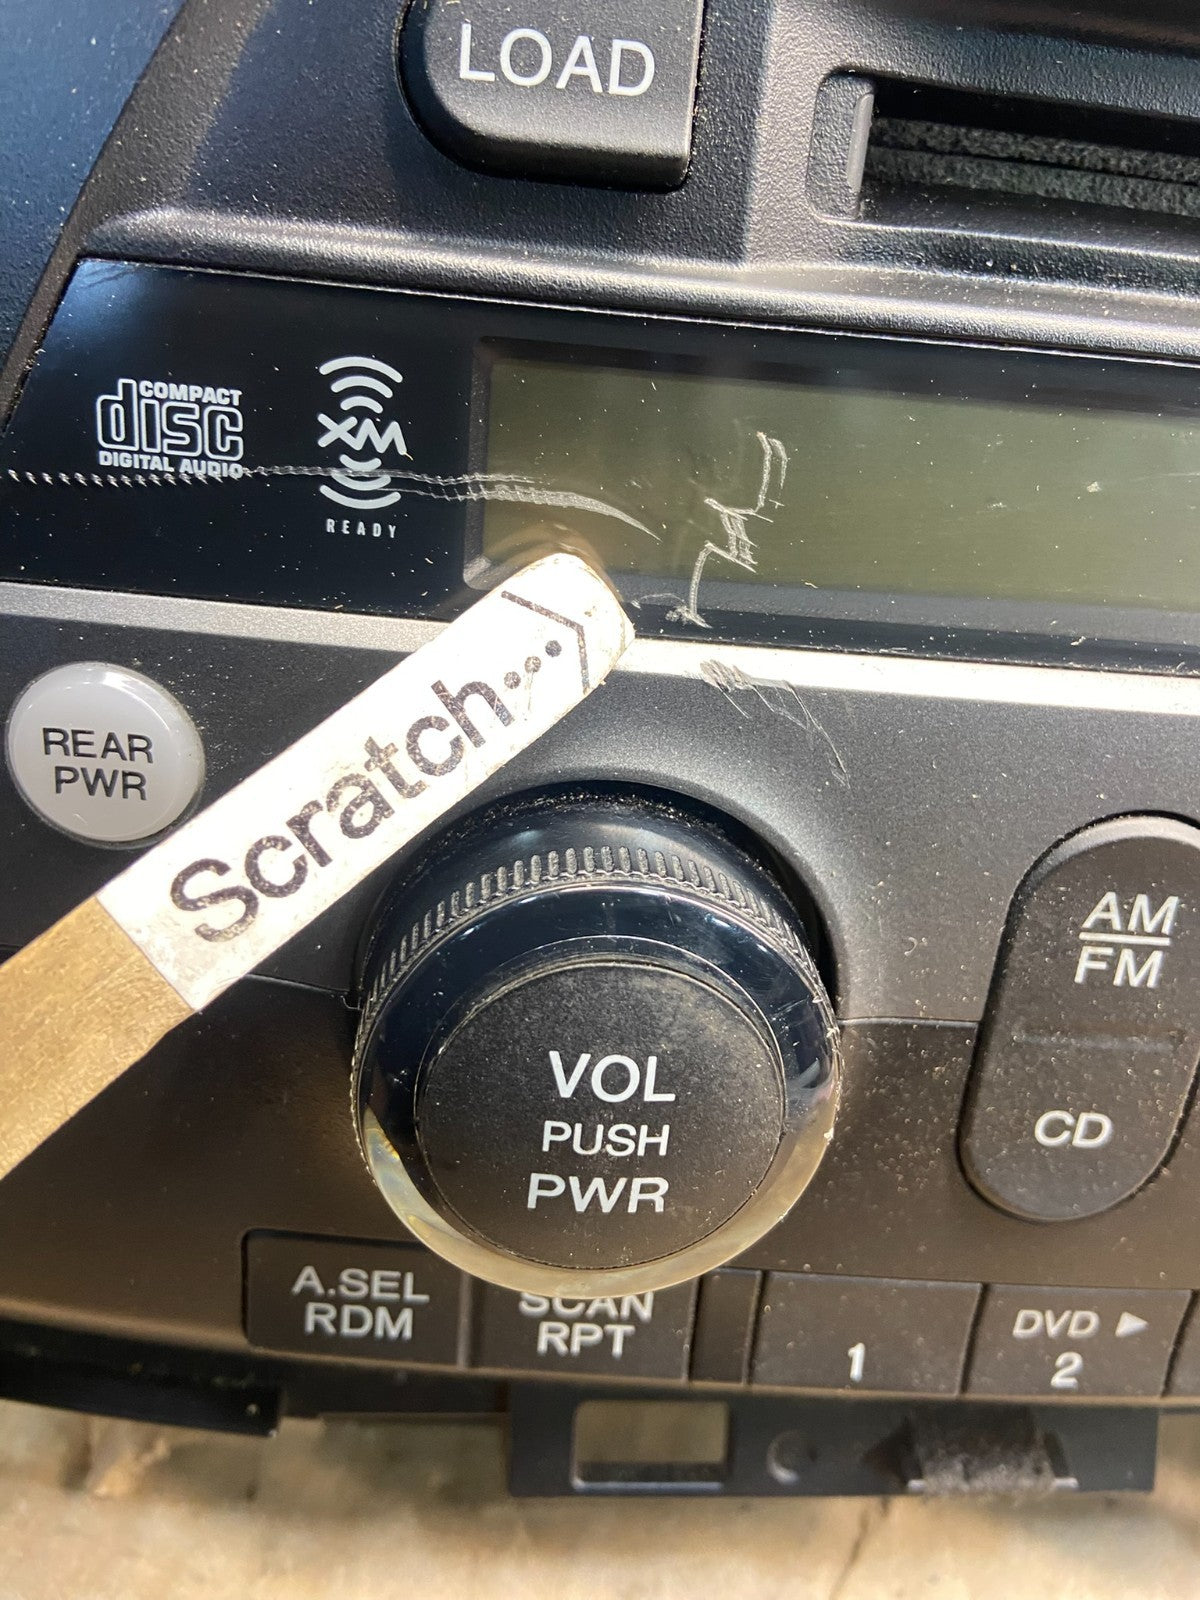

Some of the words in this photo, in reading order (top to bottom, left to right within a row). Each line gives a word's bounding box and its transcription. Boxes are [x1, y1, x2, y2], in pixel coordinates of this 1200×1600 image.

[458, 24, 656, 98] LOAD
[139, 380, 242, 406] COMPACT
[95, 378, 244, 462] disc
[98, 450, 175, 474] DIGITAL
[180, 458, 245, 479] AUDIO
[326, 518, 398, 539] READY
[42, 726, 154, 764] REAR
[54, 766, 148, 800] PWR
[1082, 891, 1179, 936] AM
[1074, 945, 1164, 989] FM
[549, 1050, 676, 1103] VOL
[542, 1120, 670, 1156] PUSH
[1034, 1110, 1113, 1148] CD
[527, 1172, 669, 1213] PWR
[292, 1265, 430, 1302] A.SEL
[304, 1302, 414, 1340] RDM
[536, 1321, 636, 1358] RPT
[1012, 1308, 1100, 1339] DVD
[847, 1341, 866, 1382] 1
[1050, 1351, 1084, 1389] 2
